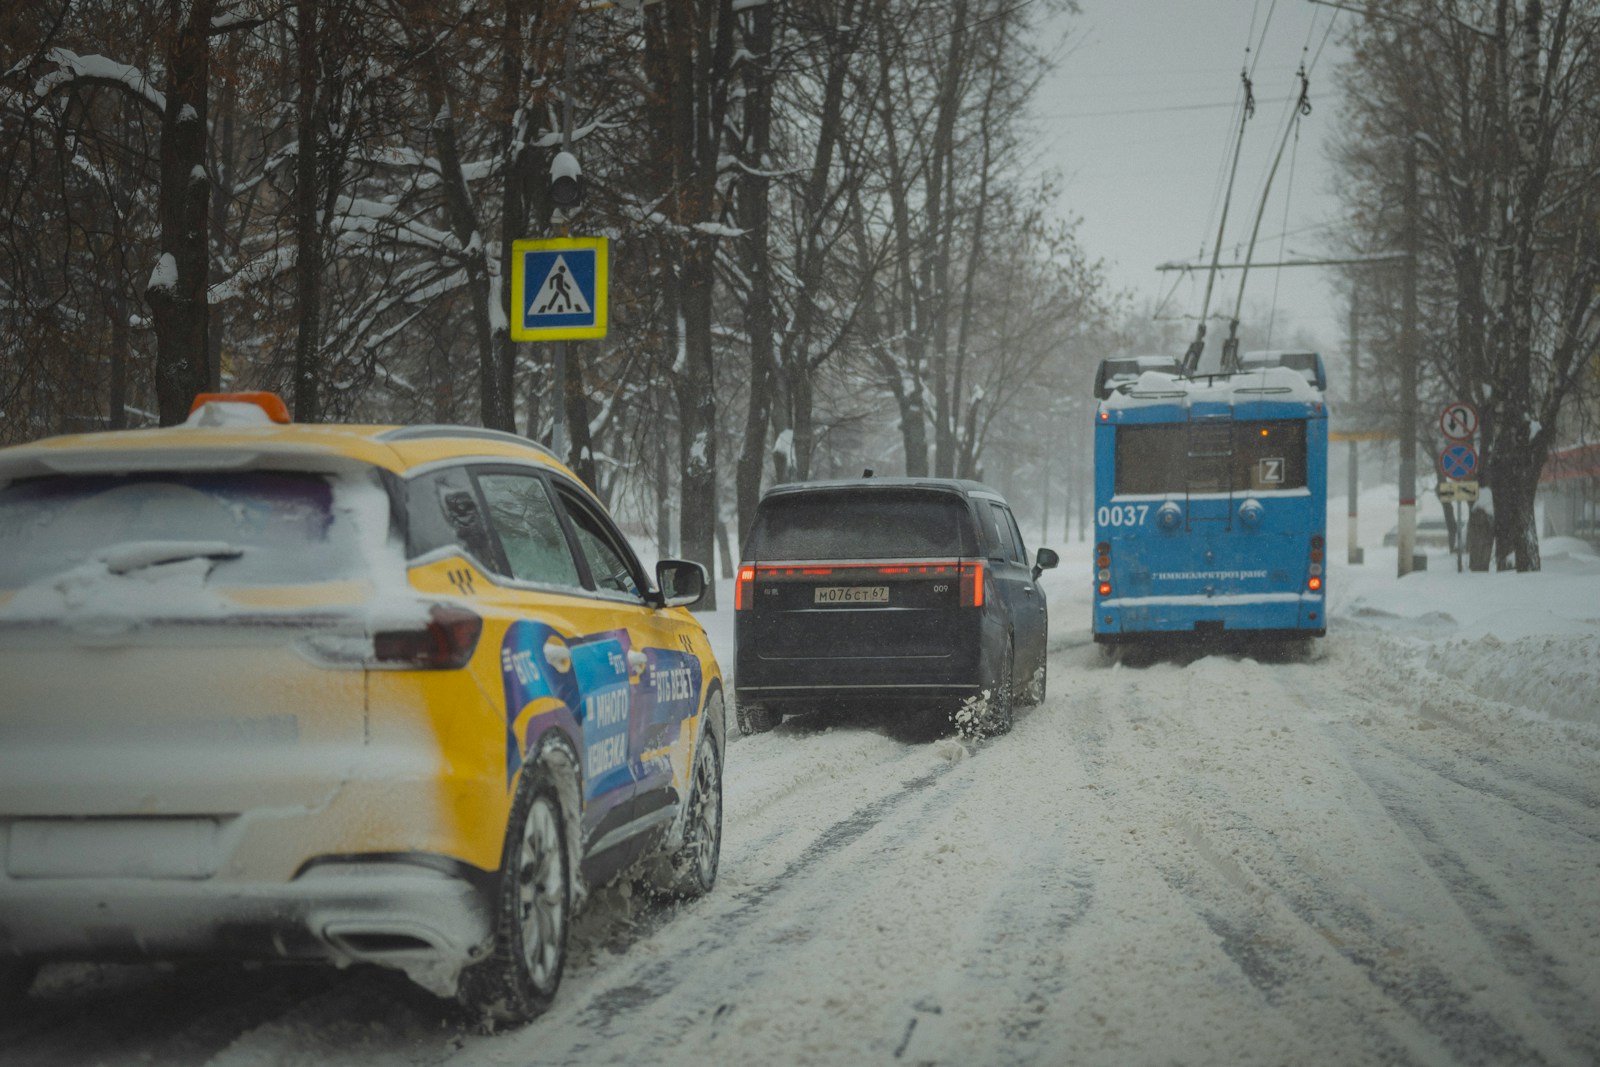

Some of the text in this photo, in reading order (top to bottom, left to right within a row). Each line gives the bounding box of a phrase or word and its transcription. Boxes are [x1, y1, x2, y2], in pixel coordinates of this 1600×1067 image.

[1264, 461, 1280, 481] Z
[1097, 505, 1149, 527] 0037
[872, 587, 885, 597] 67
[933, 584, 949, 593] 009
[512, 650, 541, 685] ВТБ
[656, 669, 671, 704] ВТБ
[596, 687, 628, 729] МНОГО
